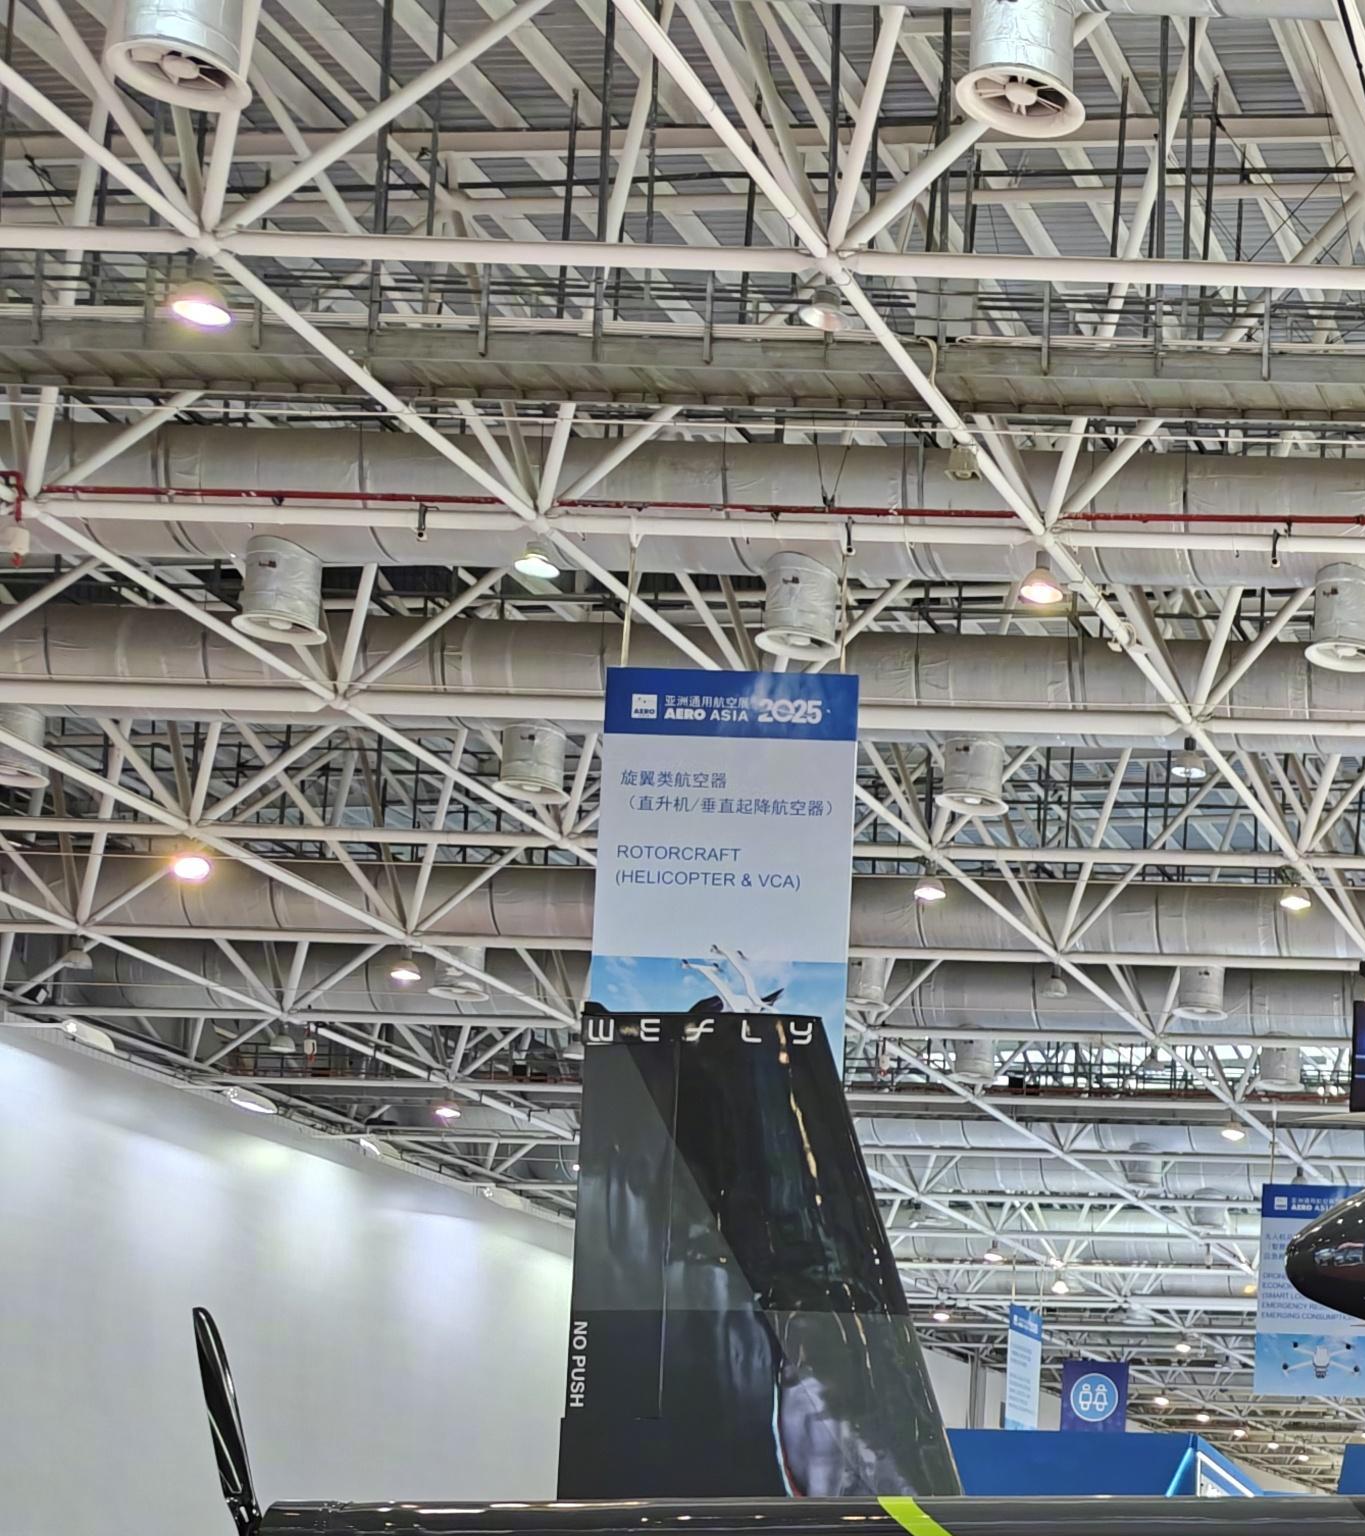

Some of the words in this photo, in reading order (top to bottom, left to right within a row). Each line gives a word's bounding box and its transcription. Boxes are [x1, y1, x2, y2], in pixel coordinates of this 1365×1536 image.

[664, 708, 706, 720] AERO
[710, 709, 749, 722] ASIA
[758, 699, 822, 724] 2025
[620, 770, 727, 789] 旋翼类航空器
[617, 845, 741, 862] ROTORCRAFT
[615, 869, 735, 887] (HELICOPTER
[741, 873, 752, 888] &
[758, 873, 801, 891] VCA)
[573, 1320, 588, 1351] NO
[569, 1355, 586, 1408] PUSH
